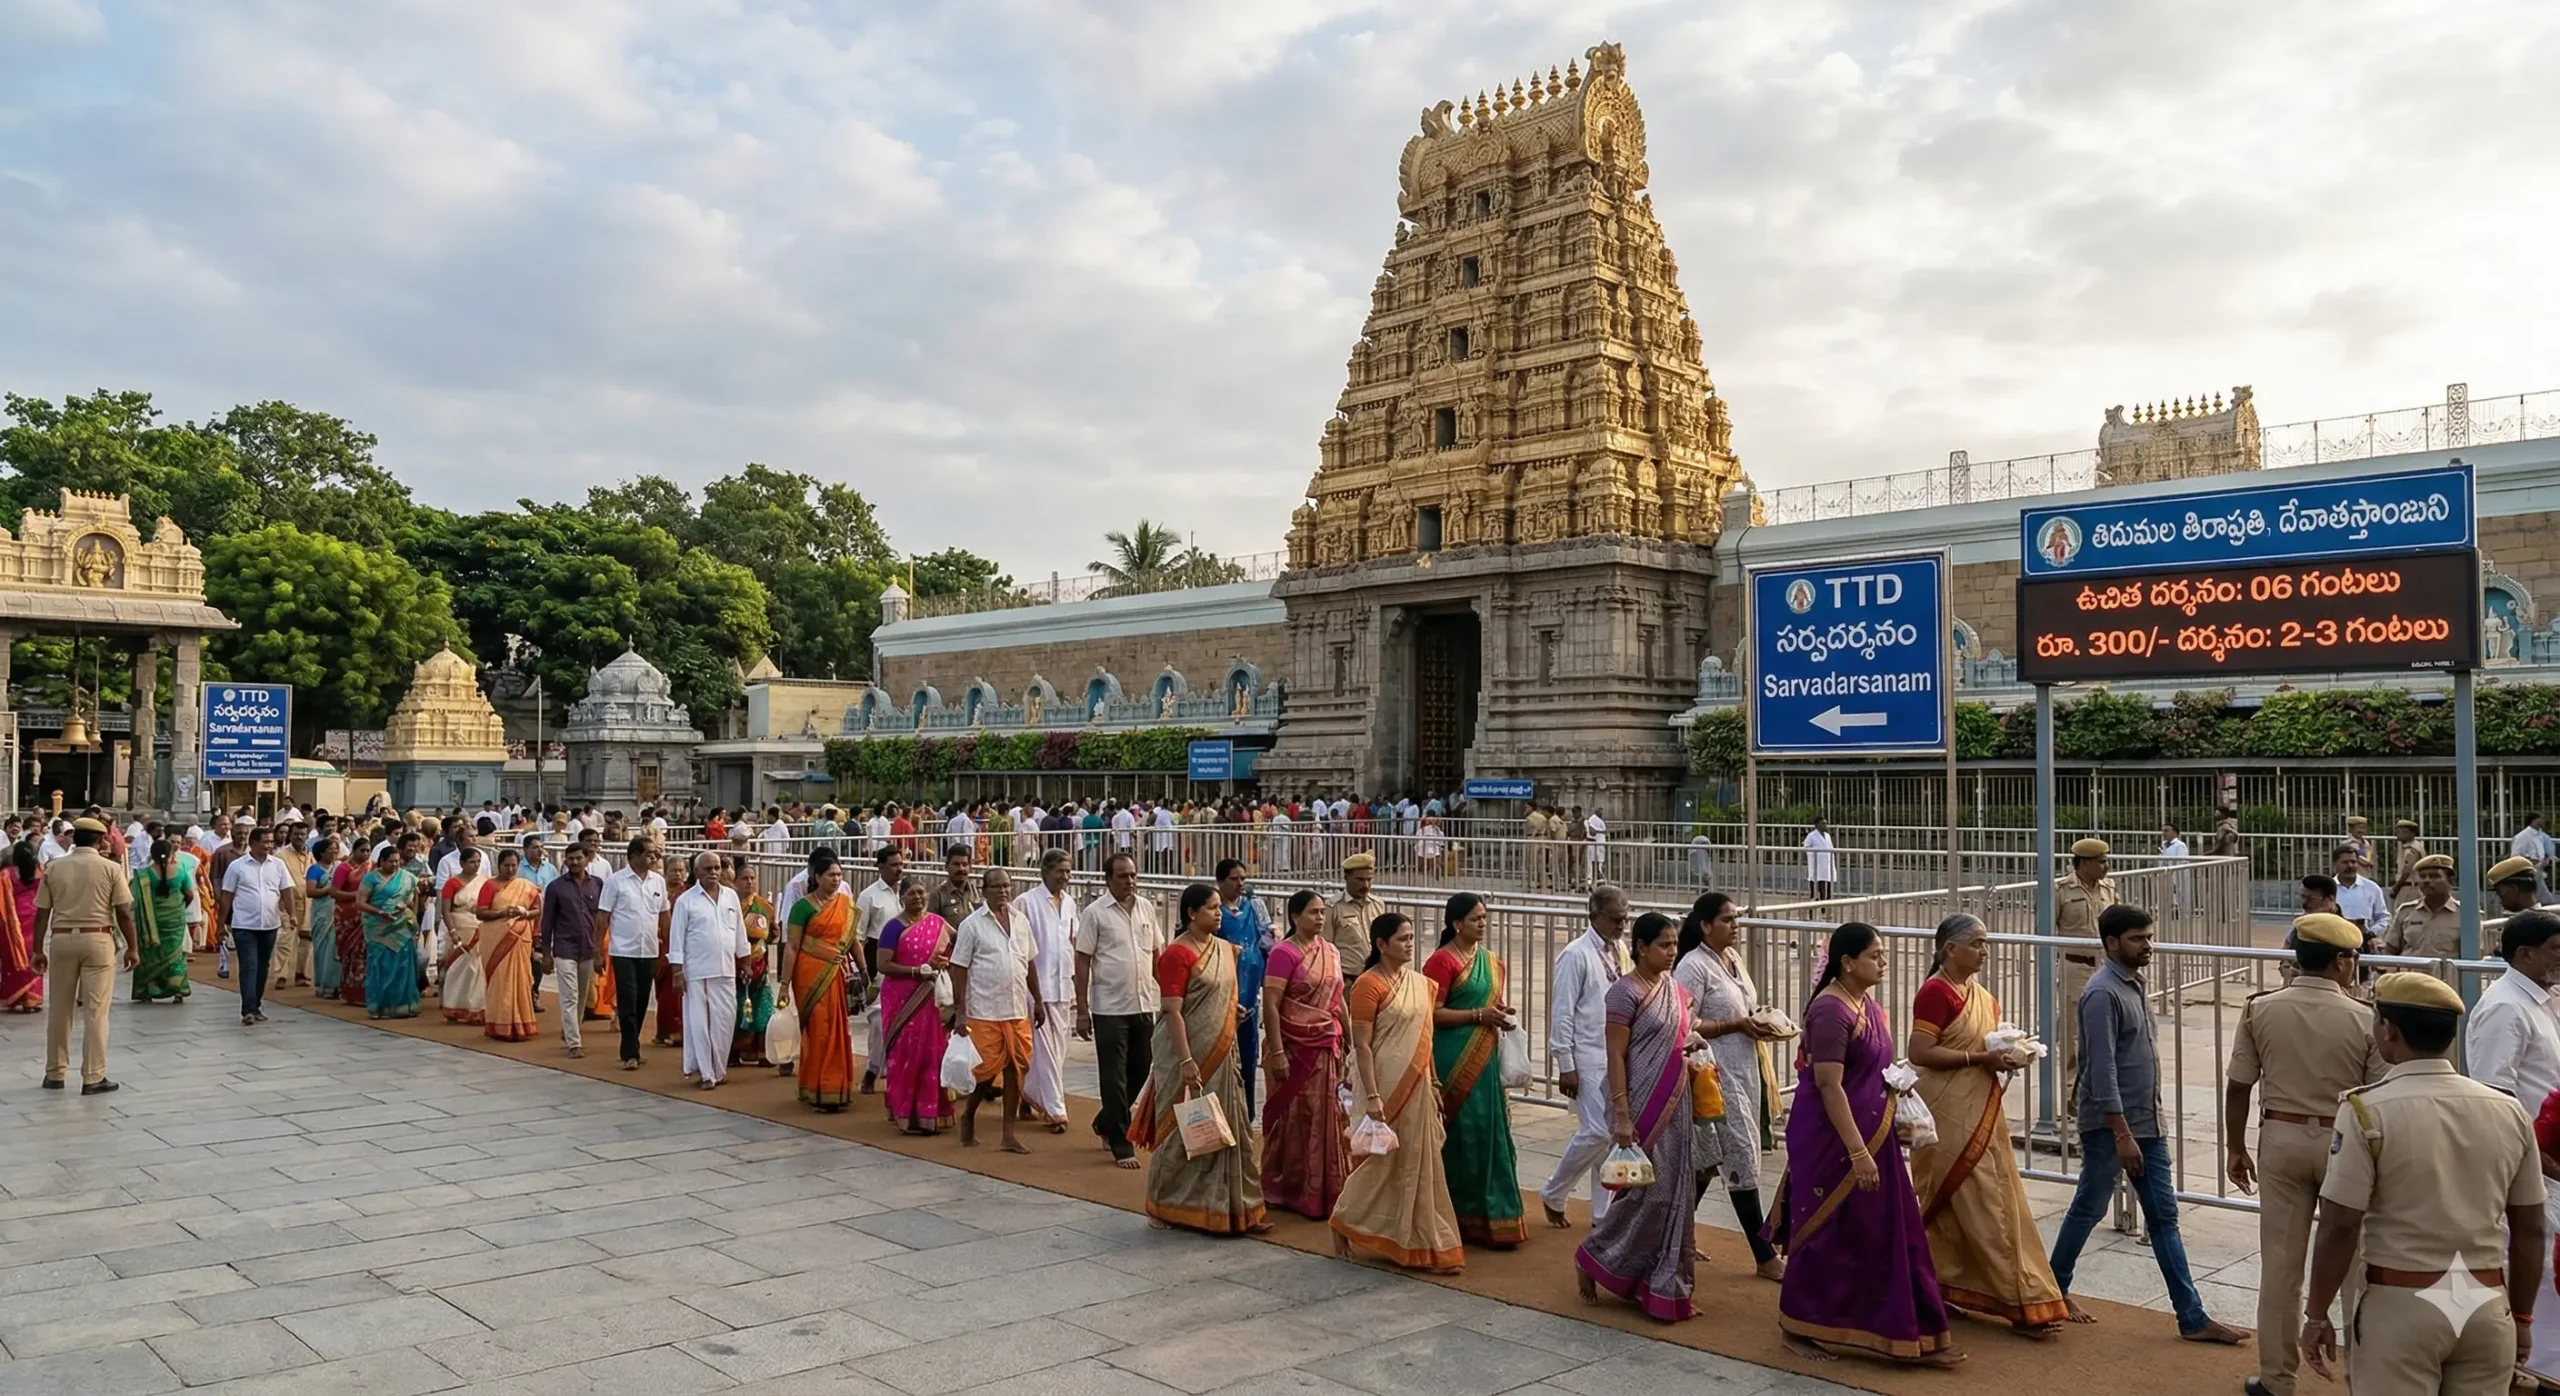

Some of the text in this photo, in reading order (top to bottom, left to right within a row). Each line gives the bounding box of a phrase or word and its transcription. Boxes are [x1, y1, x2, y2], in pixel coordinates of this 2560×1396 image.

[1825, 573, 1903, 608] TTD
[2076, 567, 2401, 617] ఉచిత దర్శనం: 06 గంటలు
[1776, 619, 1917, 662] సర్వదర్శనం
[2036, 633, 2081, 657] రూ.
[2088, 625, 2170, 658] 300/-
[2280, 620, 2338, 647] 2-3
[2345, 614, 2449, 643] గంటలు
[239, 690, 270, 702] TTD
[1764, 671, 1931, 698] Sarvadarsanam
